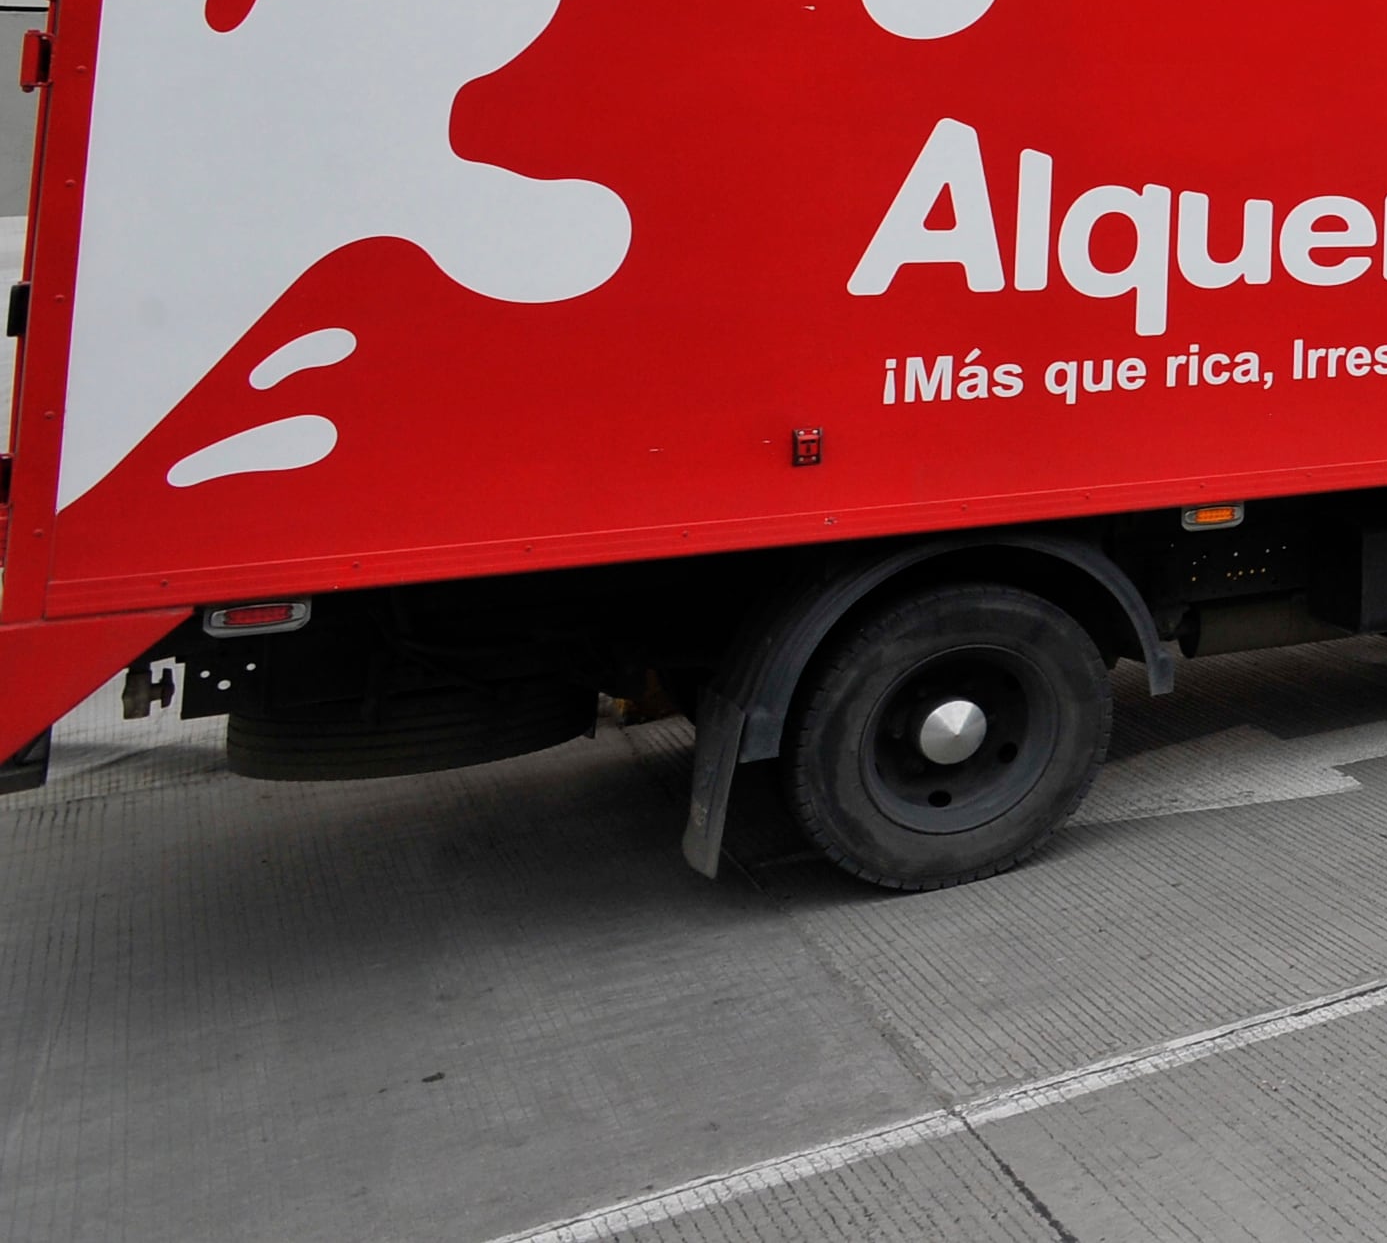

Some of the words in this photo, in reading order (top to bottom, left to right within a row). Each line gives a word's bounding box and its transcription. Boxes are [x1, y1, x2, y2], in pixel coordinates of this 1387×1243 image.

[883, 347, 1024, 405] ¡Más
[1044, 357, 1147, 405] que
[1166, 343, 1274, 390] rica,
